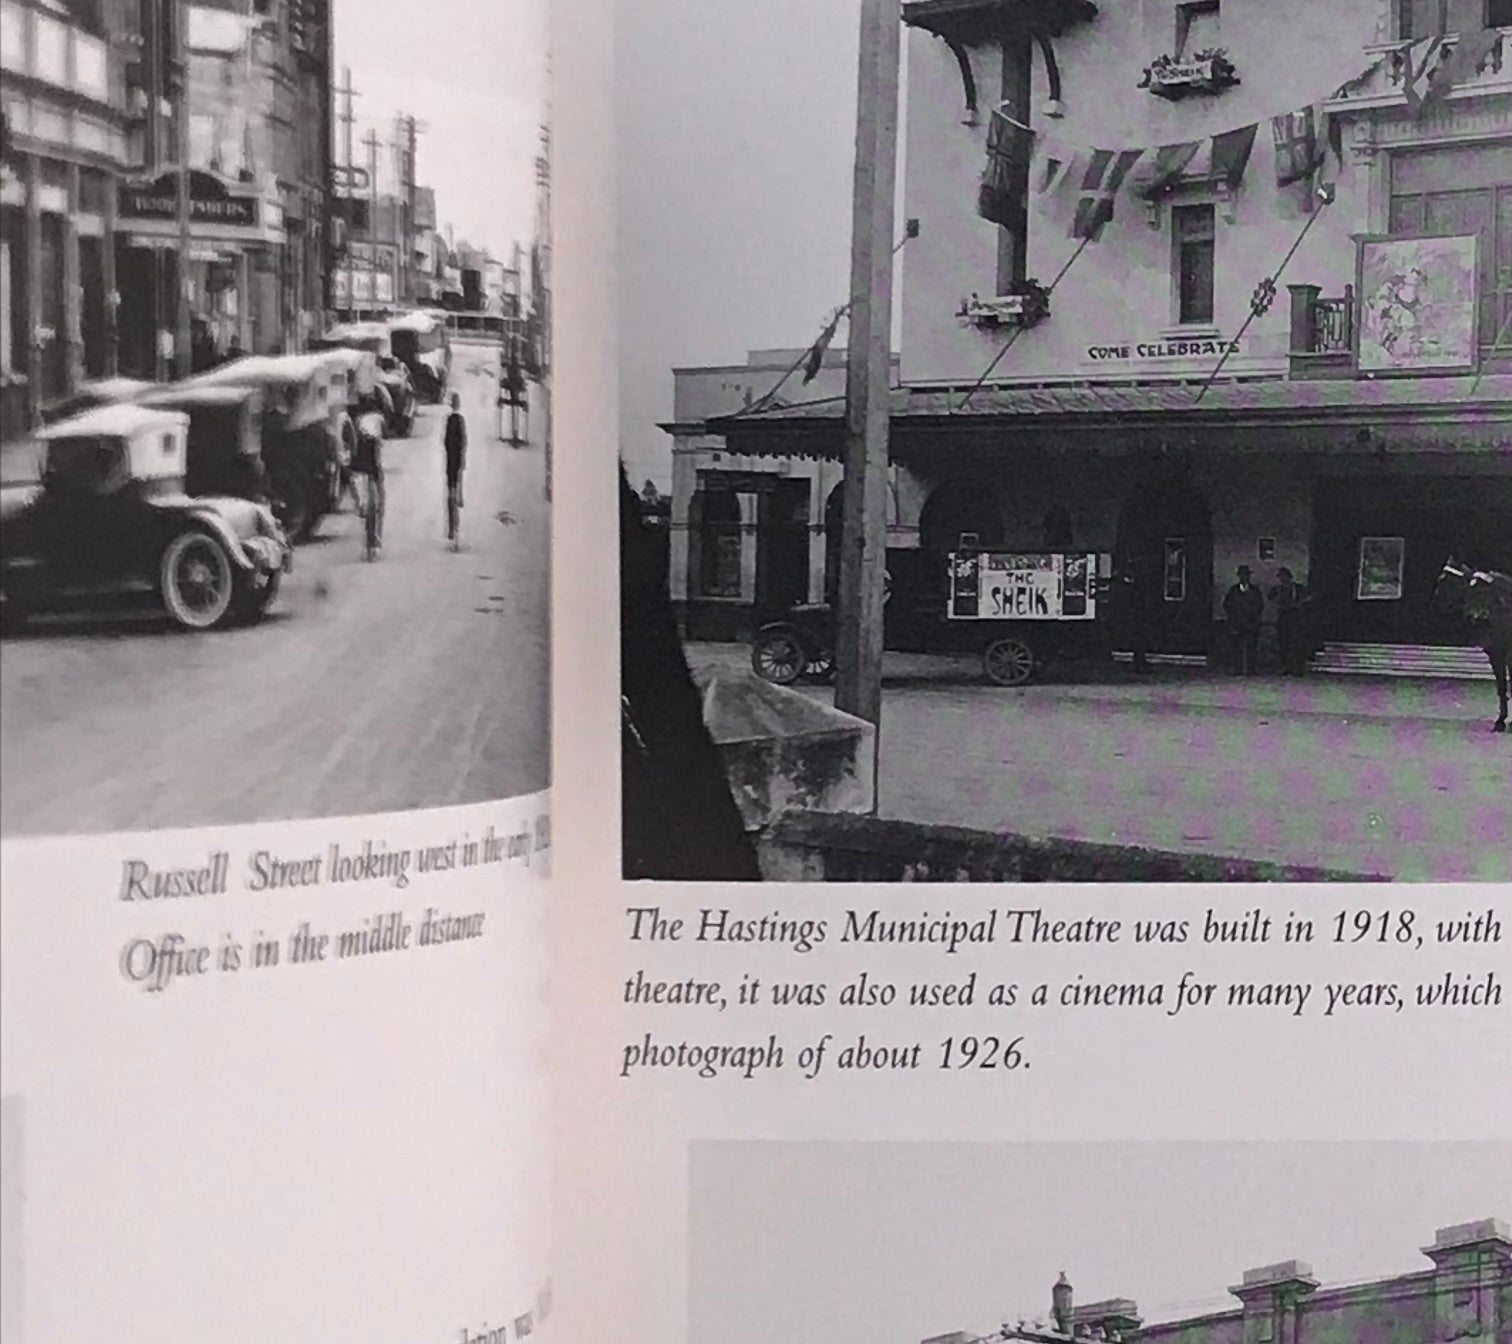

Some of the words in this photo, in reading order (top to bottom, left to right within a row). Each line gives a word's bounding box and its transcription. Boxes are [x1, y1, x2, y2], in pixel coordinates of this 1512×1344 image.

[1088, 346, 1131, 360] COME
[1136, 340, 1240, 357] CELEBRATE
[991, 586, 1048, 616] SHEIK
[122, 852, 229, 902] Russell
[249, 850, 323, 891] Street
[331, 843, 410, 890] looking
[415, 839, 456, 873] west
[123, 933, 209, 993] Office
[253, 931, 279, 969] in
[289, 922, 329, 964] the
[337, 912, 411, 957] middle
[625, 907, 684, 942] The
[695, 909, 828, 954] Hastings
[840, 908, 997, 954] Municipal
[1006, 907, 1121, 944] Theatre
[1133, 920, 1190, 944] was
[1202, 906, 1272, 944] built
[1284, 910, 1315, 943] in
[1332, 909, 1423, 950] 1918,
[1436, 908, 1502, 944] with
[624, 970, 727, 1012] theatre,
[739, 973, 761, 1006] it
[771, 984, 827, 1006] was
[839, 972, 896, 1006] also
[909, 972, 977, 1006] used
[988, 984, 1019, 1006] as
[1031, 984, 1048, 1006] a
[1059, 972, 1164, 1006] cinema
[1166, 972, 1218, 1016] for
[1226, 982, 1312, 1016] many
[1323, 982, 1405, 1016] years,
[1416, 971, 1503, 1006] which
[619, 1033, 784, 1079] photograph
[797, 1034, 834, 1079] of
[838, 1034, 921, 1070] about
[939, 1036, 1031, 1071] 1926.
